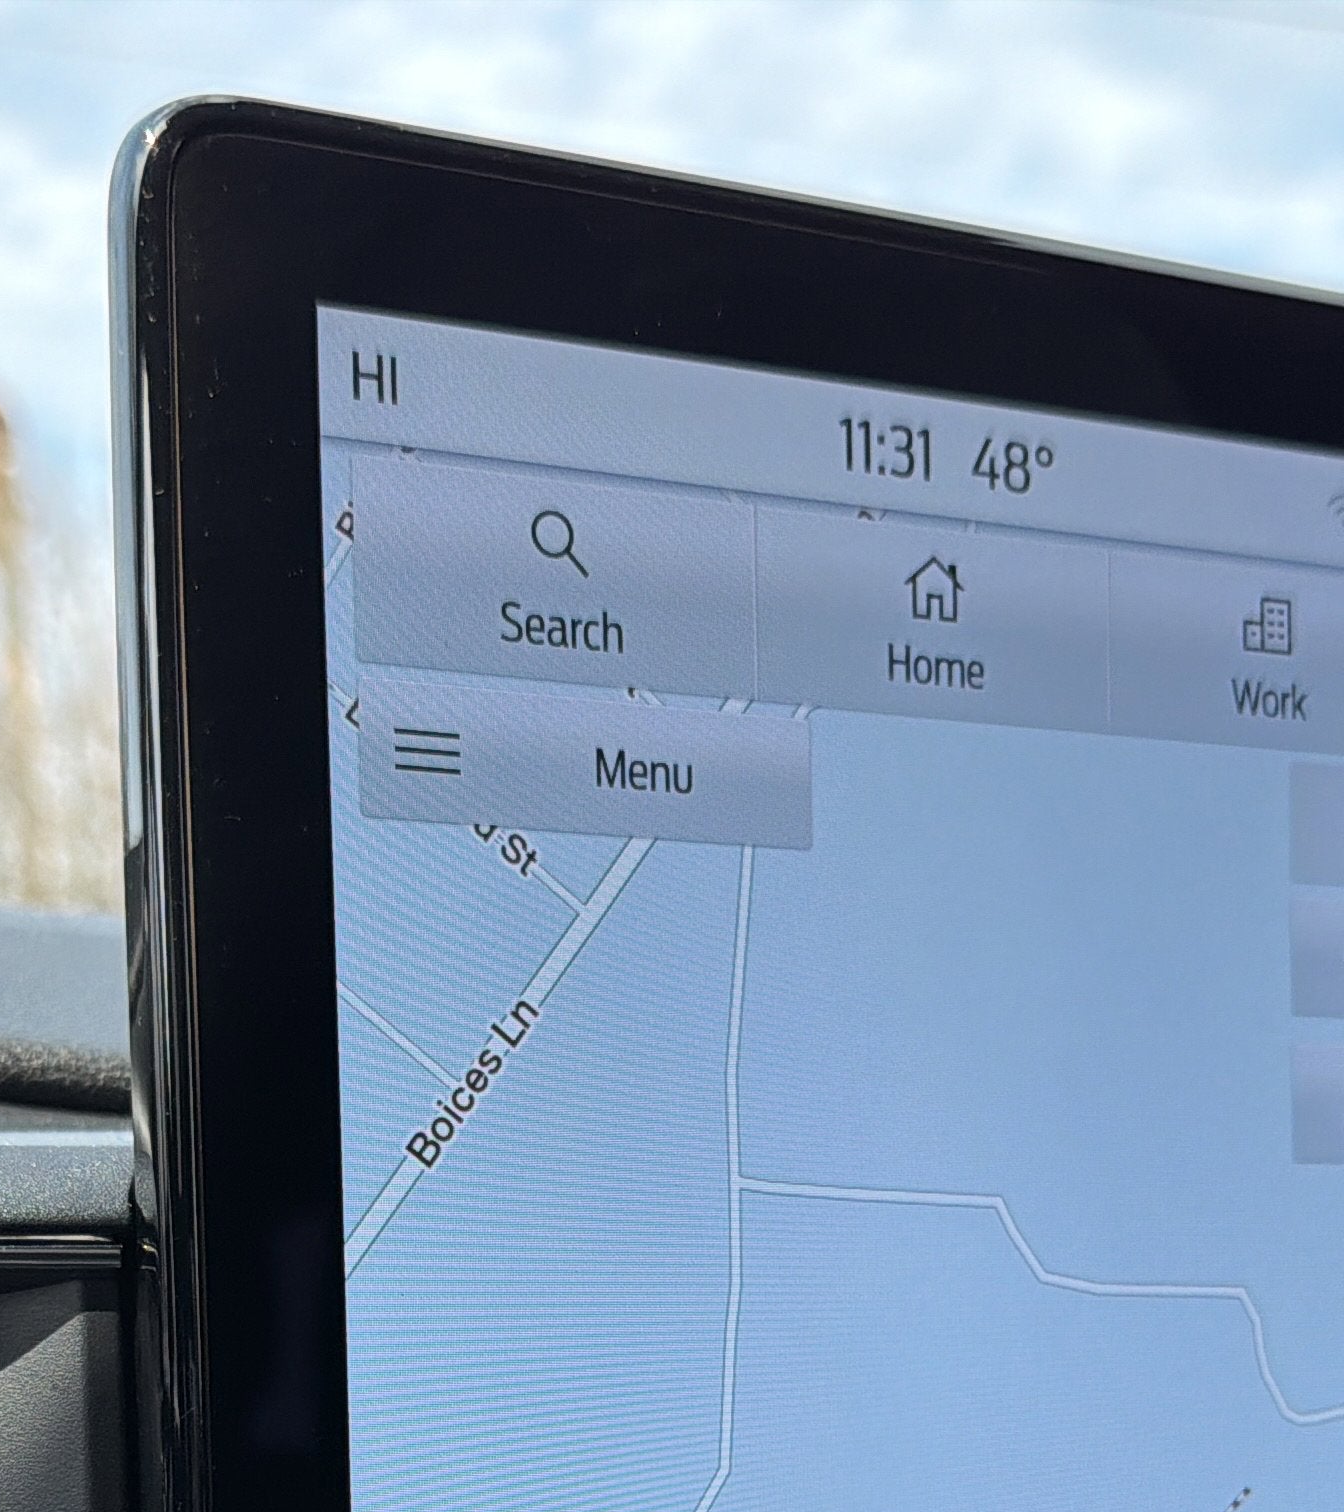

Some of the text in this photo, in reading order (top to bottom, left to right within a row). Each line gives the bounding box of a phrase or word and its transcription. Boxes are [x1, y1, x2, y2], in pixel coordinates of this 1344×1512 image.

[351, 350, 398, 406] HI
[838, 417, 1055, 495] 11:31 48°
[499, 602, 626, 654] Search
[887, 642, 985, 690] Home
[1232, 678, 1307, 721] Work
[594, 749, 694, 795] Menu
[405, 999, 541, 1168] Boices Ln
